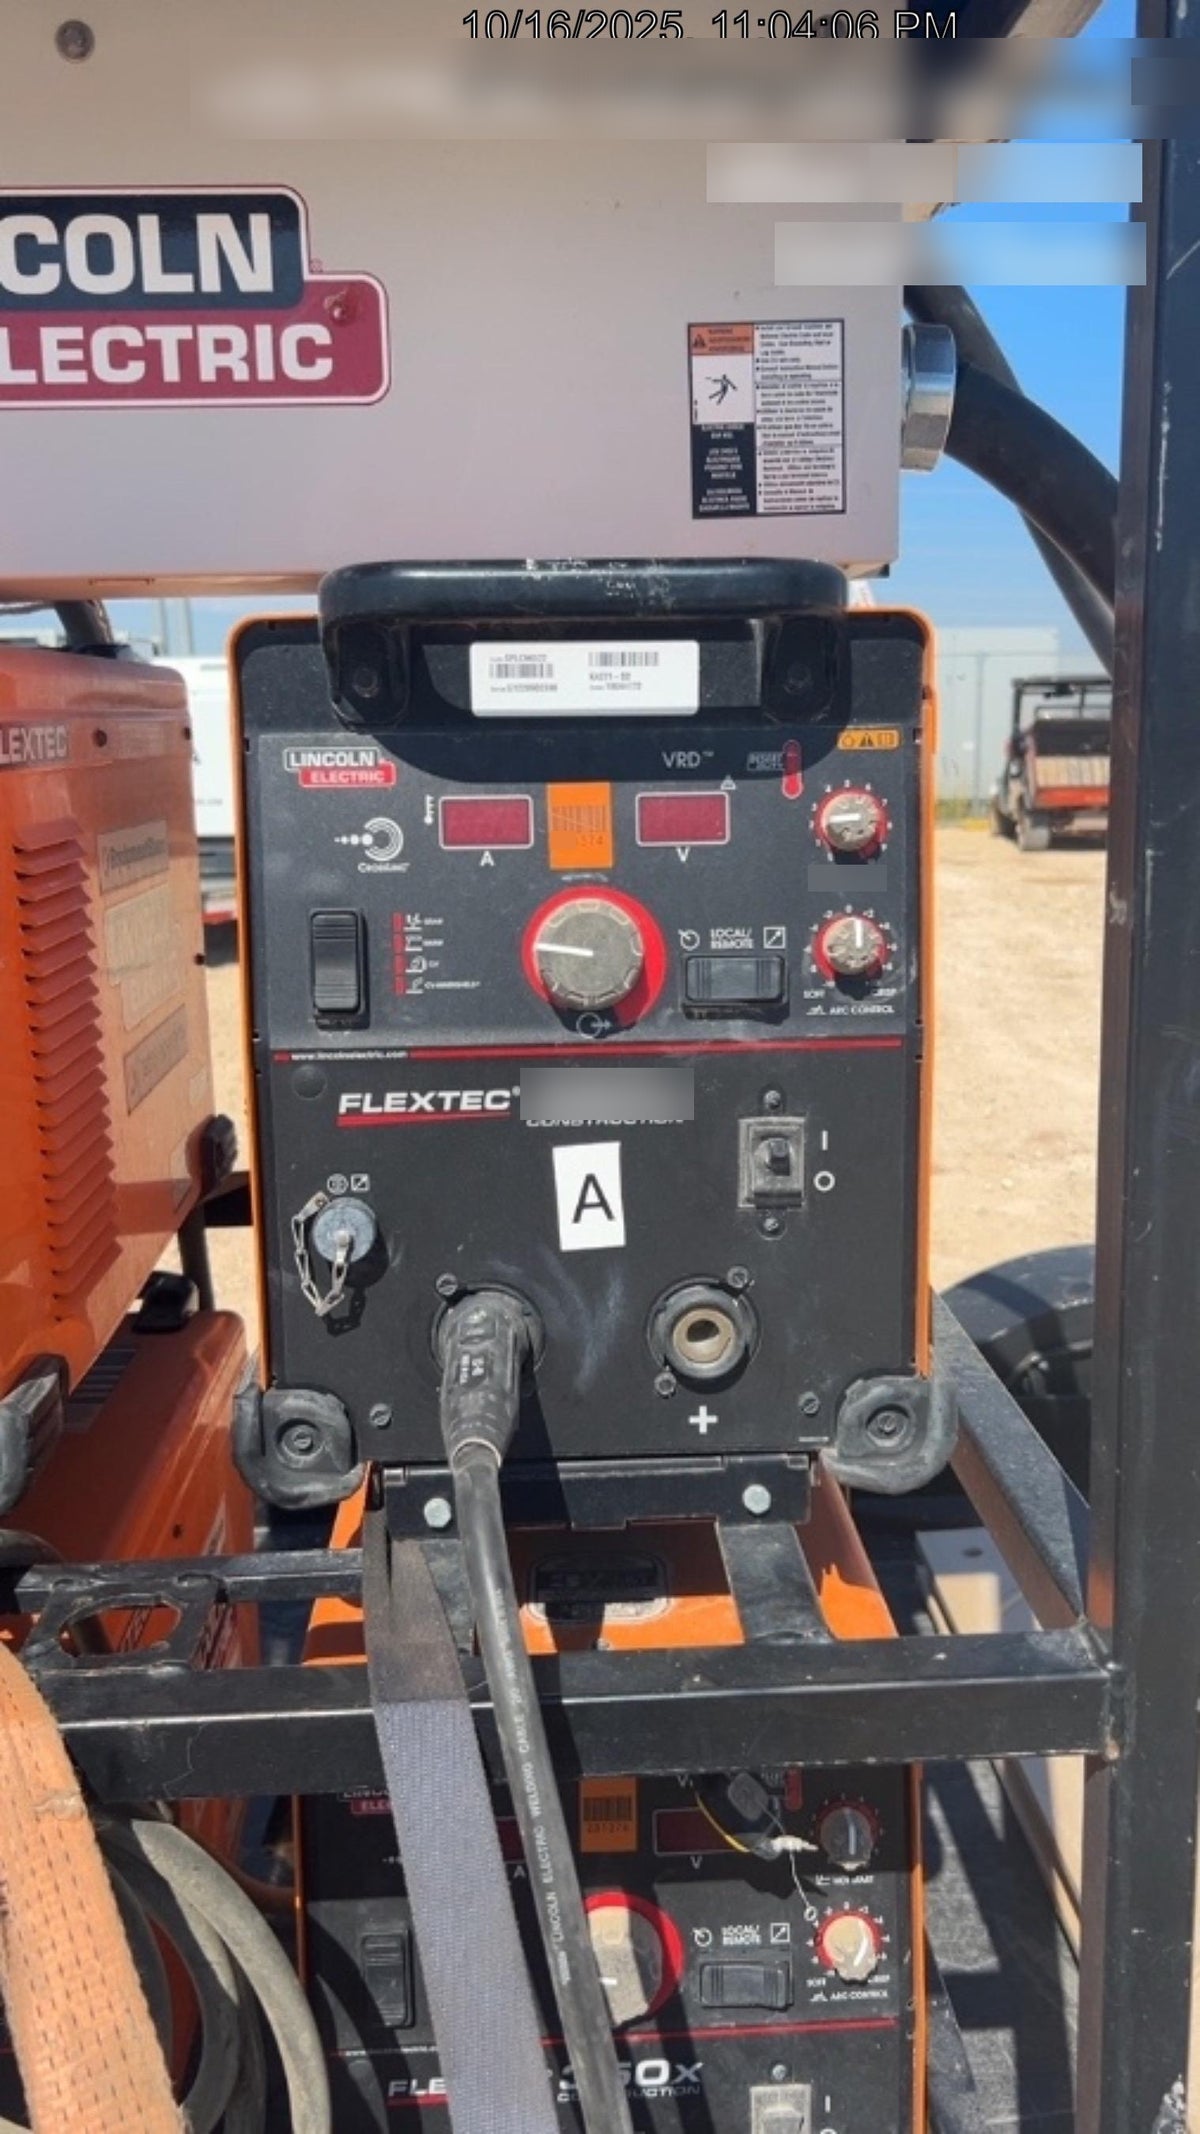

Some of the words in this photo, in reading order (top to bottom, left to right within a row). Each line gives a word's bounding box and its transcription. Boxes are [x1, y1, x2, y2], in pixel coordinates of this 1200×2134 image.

[290, 751, 375, 767] LINCOLN
[310, 770, 385, 784] ELECTRIC
[479, 850, 495, 867] A
[676, 847, 690, 864] V
[572, 1173, 616, 1224] A
[511, 1713, 530, 1754] CABLE
[520, 1761, 543, 1818] WELDING
[532, 1825, 554, 1884] ELECTRIC
